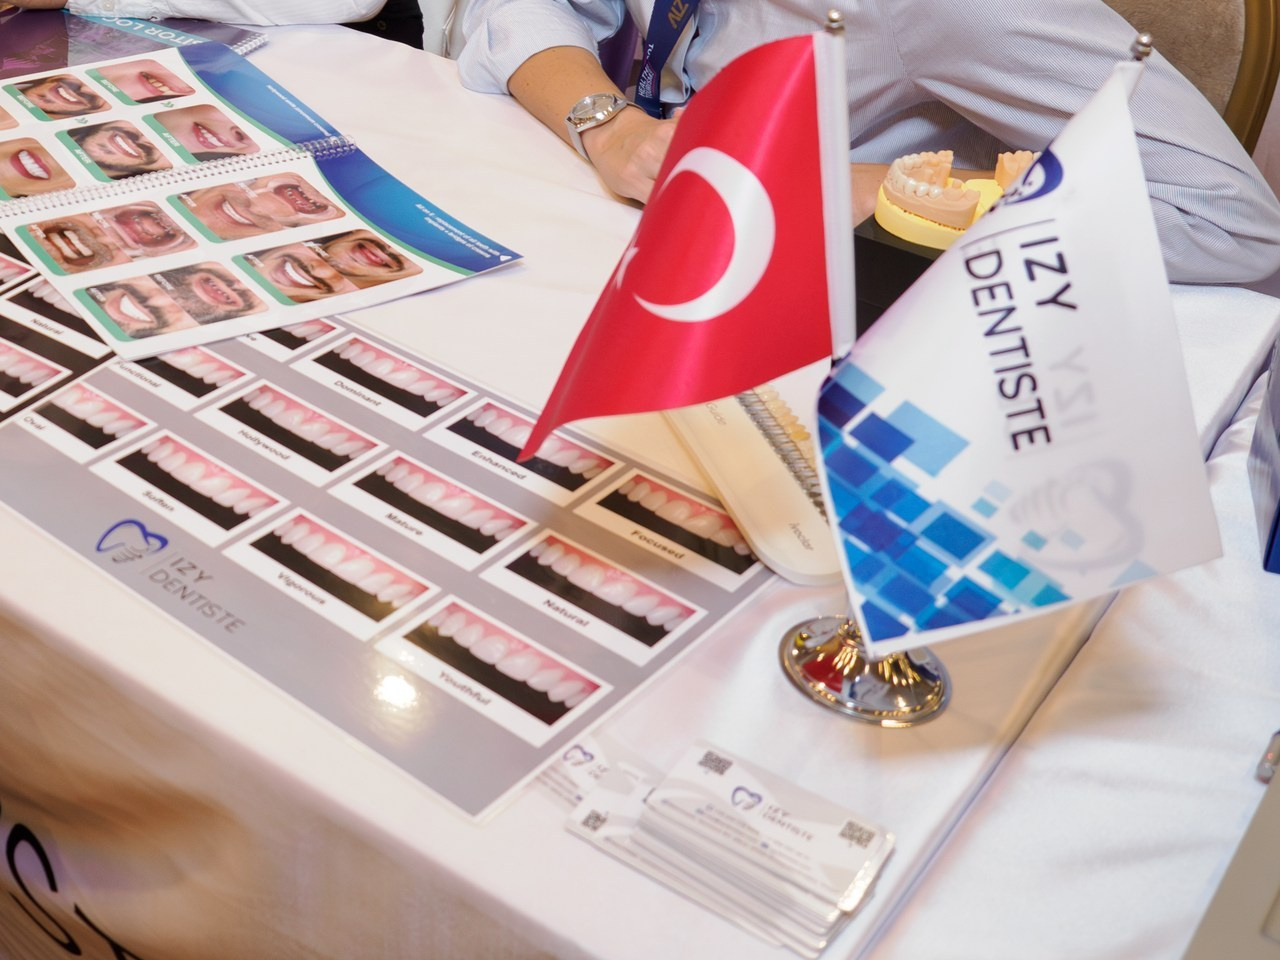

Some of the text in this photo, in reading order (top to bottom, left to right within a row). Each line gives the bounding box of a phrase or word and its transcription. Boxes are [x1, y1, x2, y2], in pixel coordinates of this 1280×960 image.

[161, 131, 181, 148] AFTER
[73, 148, 92, 164] AFTER
[1019, 236, 1079, 311] IZY
[28, 317, 65, 337] Natural
[964, 248, 1052, 451] DENTISTE
[115, 360, 163, 389] Functional
[333, 379, 383, 408] Dominant
[23, 415, 48, 432] Oval
[238, 428, 291, 462] Hollywood
[470, 449, 528, 481] Enhanced
[384, 512, 424, 537] Mature
[630, 528, 686, 560] Focused
[170, 557, 215, 584] IZY
[148, 568, 247, 635] DENTISTE
[276, 571, 327, 606] Vigorous
[542, 598, 590, 628] Natural
[438, 670, 493, 706] Youthful
